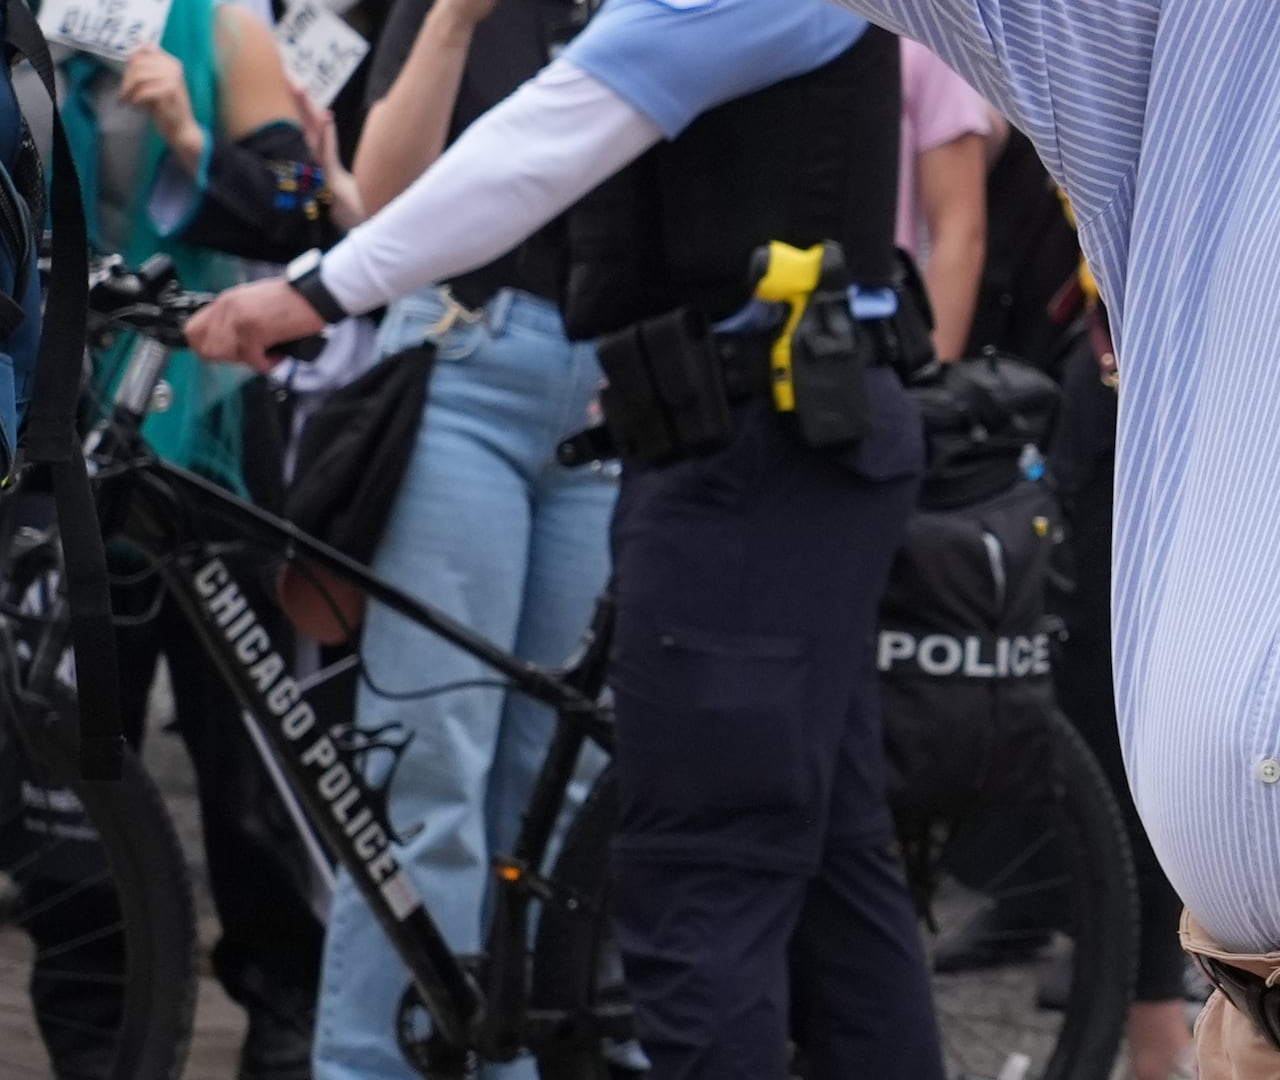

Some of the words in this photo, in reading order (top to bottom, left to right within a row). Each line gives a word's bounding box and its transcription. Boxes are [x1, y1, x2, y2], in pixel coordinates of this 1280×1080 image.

[194, 557, 317, 742] CHICAGO
[301, 735, 400, 884] POLICE
[876, 628, 1051, 678] POLICE
